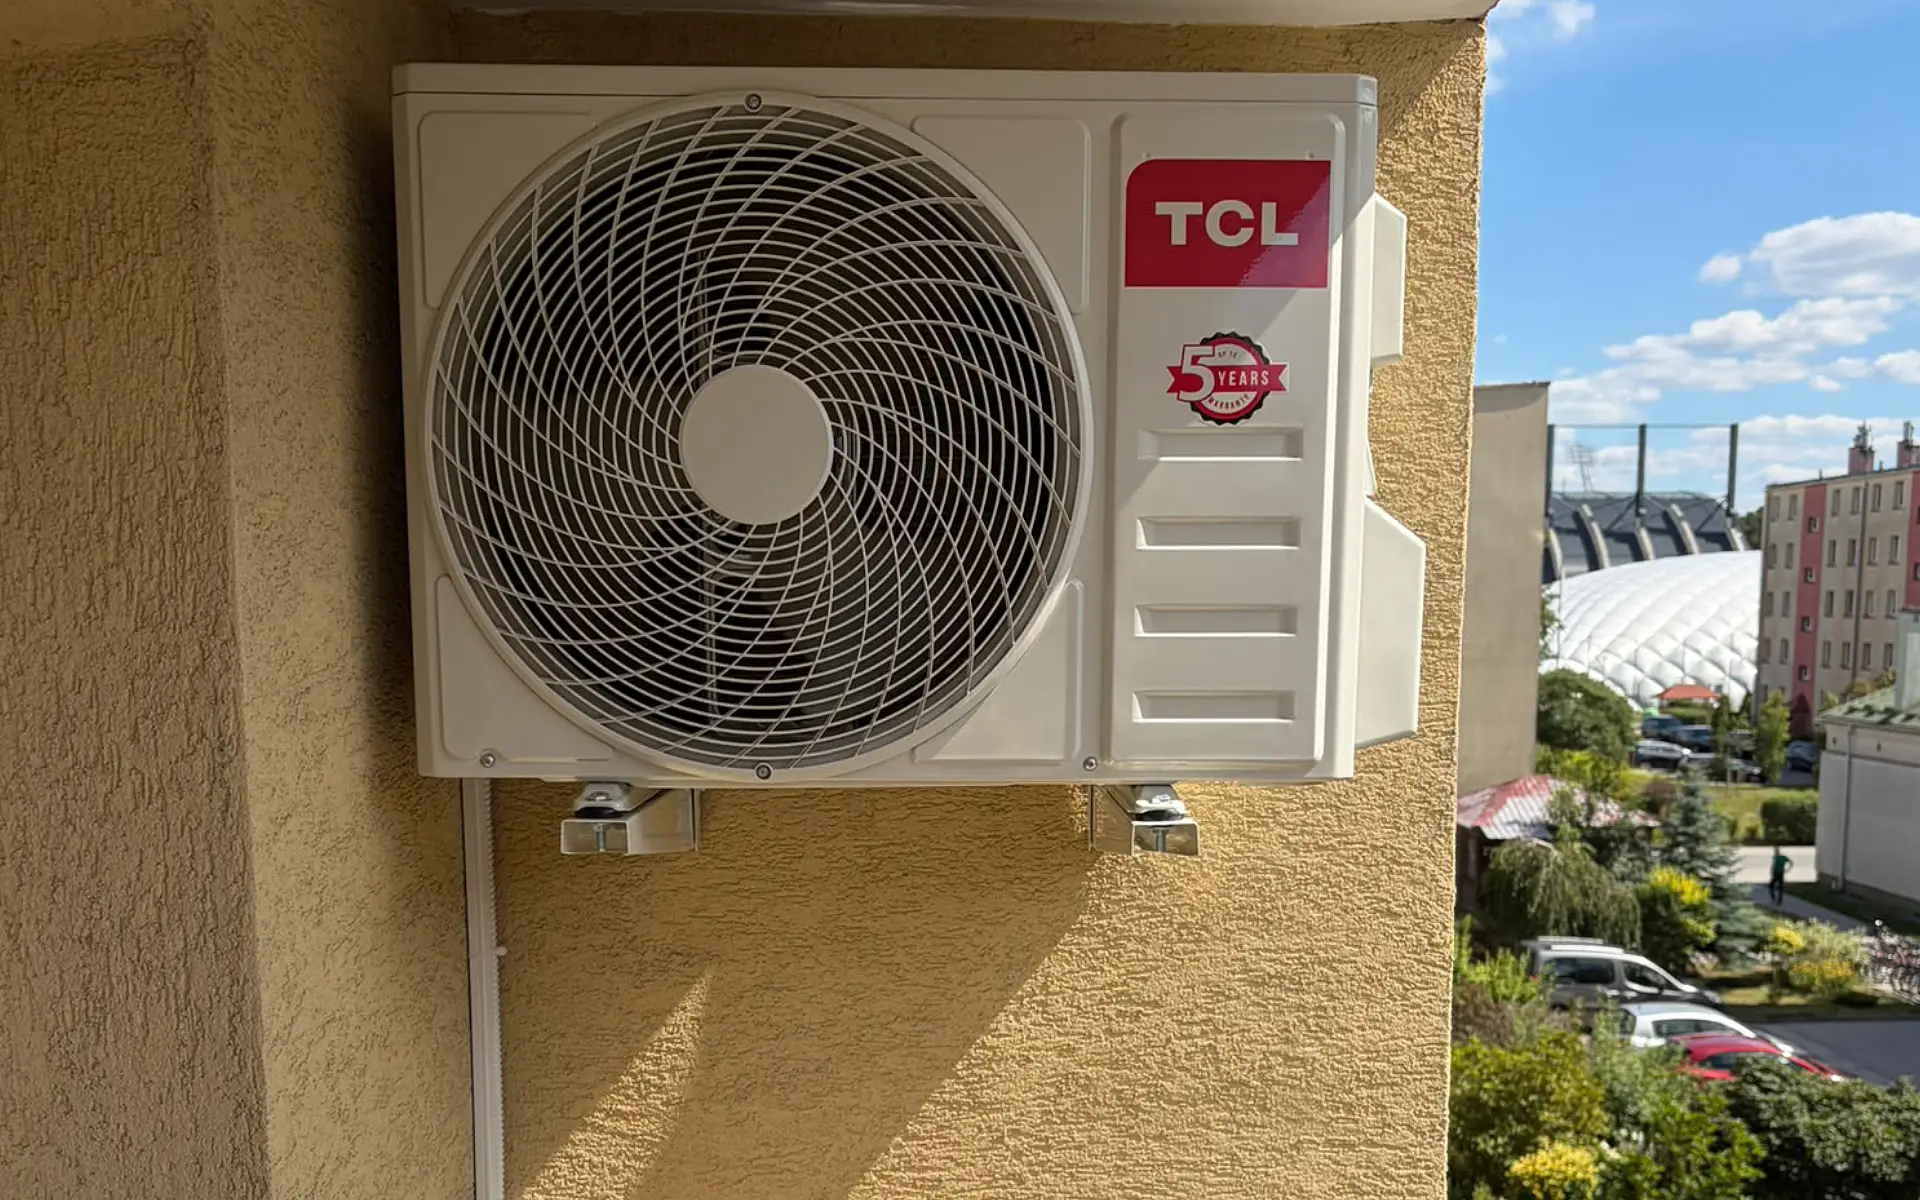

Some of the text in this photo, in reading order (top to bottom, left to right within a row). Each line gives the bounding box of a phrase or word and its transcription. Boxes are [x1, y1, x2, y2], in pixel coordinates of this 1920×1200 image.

[1155, 199, 1299, 247] TCL
[1176, 344, 1269, 402] 5 YEARS
